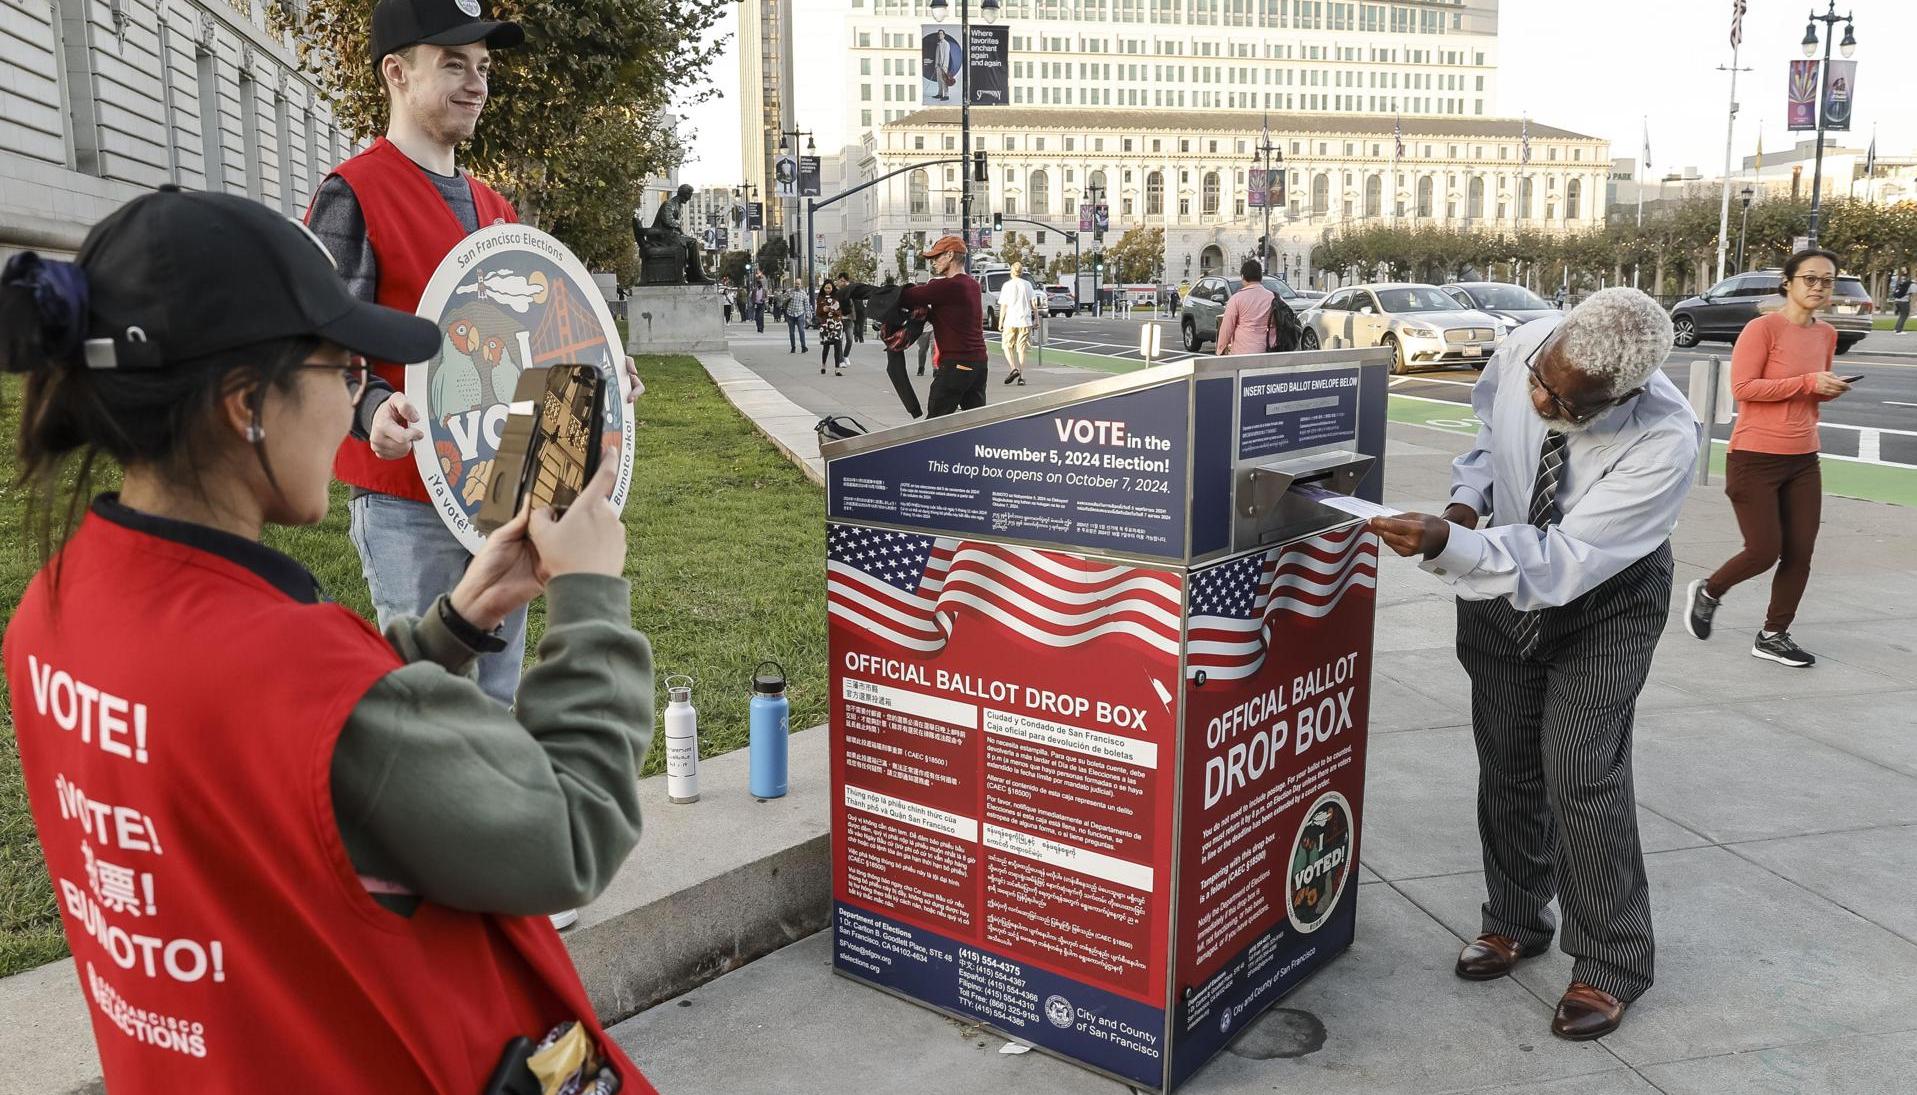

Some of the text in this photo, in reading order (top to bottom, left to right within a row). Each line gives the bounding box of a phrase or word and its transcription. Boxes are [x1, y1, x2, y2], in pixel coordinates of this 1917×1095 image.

[971, 37, 999, 45] favorites
[971, 52, 989, 60] again
[984, 60, 1002, 68] again
[1612, 172, 1632, 181] PARK
[457, 232, 564, 268] San Francisco Elections
[1243, 377, 1358, 398] INSERT SIGNED BALLOT ENVELOPE BELOW
[1055, 418, 1171, 451] VOTE in the
[613, 420, 632, 506] Bumoto ako!
[974, 444, 1170, 473] November 5, 2024 Election!
[928, 461, 1171, 494] This drop box opens on October 7, 2024.
[443, 497, 468, 534] voté!
[844, 651, 1148, 731] OFFICIAL BALLOT DROP BOX
[1207, 651, 1358, 749] OFFICIAL BALLOT
[28, 654, 149, 764] VOTE!
[986, 720, 1134, 762] Caja oficial para devolución de boletas
[987, 710, 1125, 748] Ciudad y Condado de San Francisco
[1204, 686, 1355, 811] DROP BOX
[986, 781, 1006, 793] (CAEC
[1202, 826, 1212, 838] You
[1230, 807, 1242, 819] need
[1249, 793, 1265, 807] include
[1287, 775, 1295, 785] For
[1296, 770, 1306, 781] your
[1307, 761, 1319, 773] ballot
[908, 814, 921, 824] San
[922, 818, 955, 834] Francisco
[1318, 832, 1325, 852] I
[1199, 831, 1275, 890] Tampering with this drop box
[1295, 845, 1345, 891] VOTED!
[1210, 878, 1227, 896] felony
[1227, 864, 1245, 884] (CAEC
[838, 907, 912, 940] Department of Elections
[839, 925, 851, 935] San
[851, 930, 881, 948] Francisco,
[881, 941, 892, 951] CA
[929, 948, 943, 960] STE
[958, 947, 1021, 976] (415) 554-4375
[958, 968, 988, 984] Español:
[987, 978, 1005, 992] (415)
[976, 964, 993, 979] (415)
[994, 971, 1026, 988] 554-4367
[1233, 946, 1316, 1017] City and County of San Francisco
[958, 978, 1035, 1011] Filipino: (415) 554-4310
[958, 988, 1040, 1023] Toll Free: (866) 325-9163
[958, 997, 975, 1008] TTY:
[975, 1003, 993, 1017] (415)
[1076, 1007, 1157, 1045] City and County
[1076, 1022, 1159, 1058] of San Francisco
